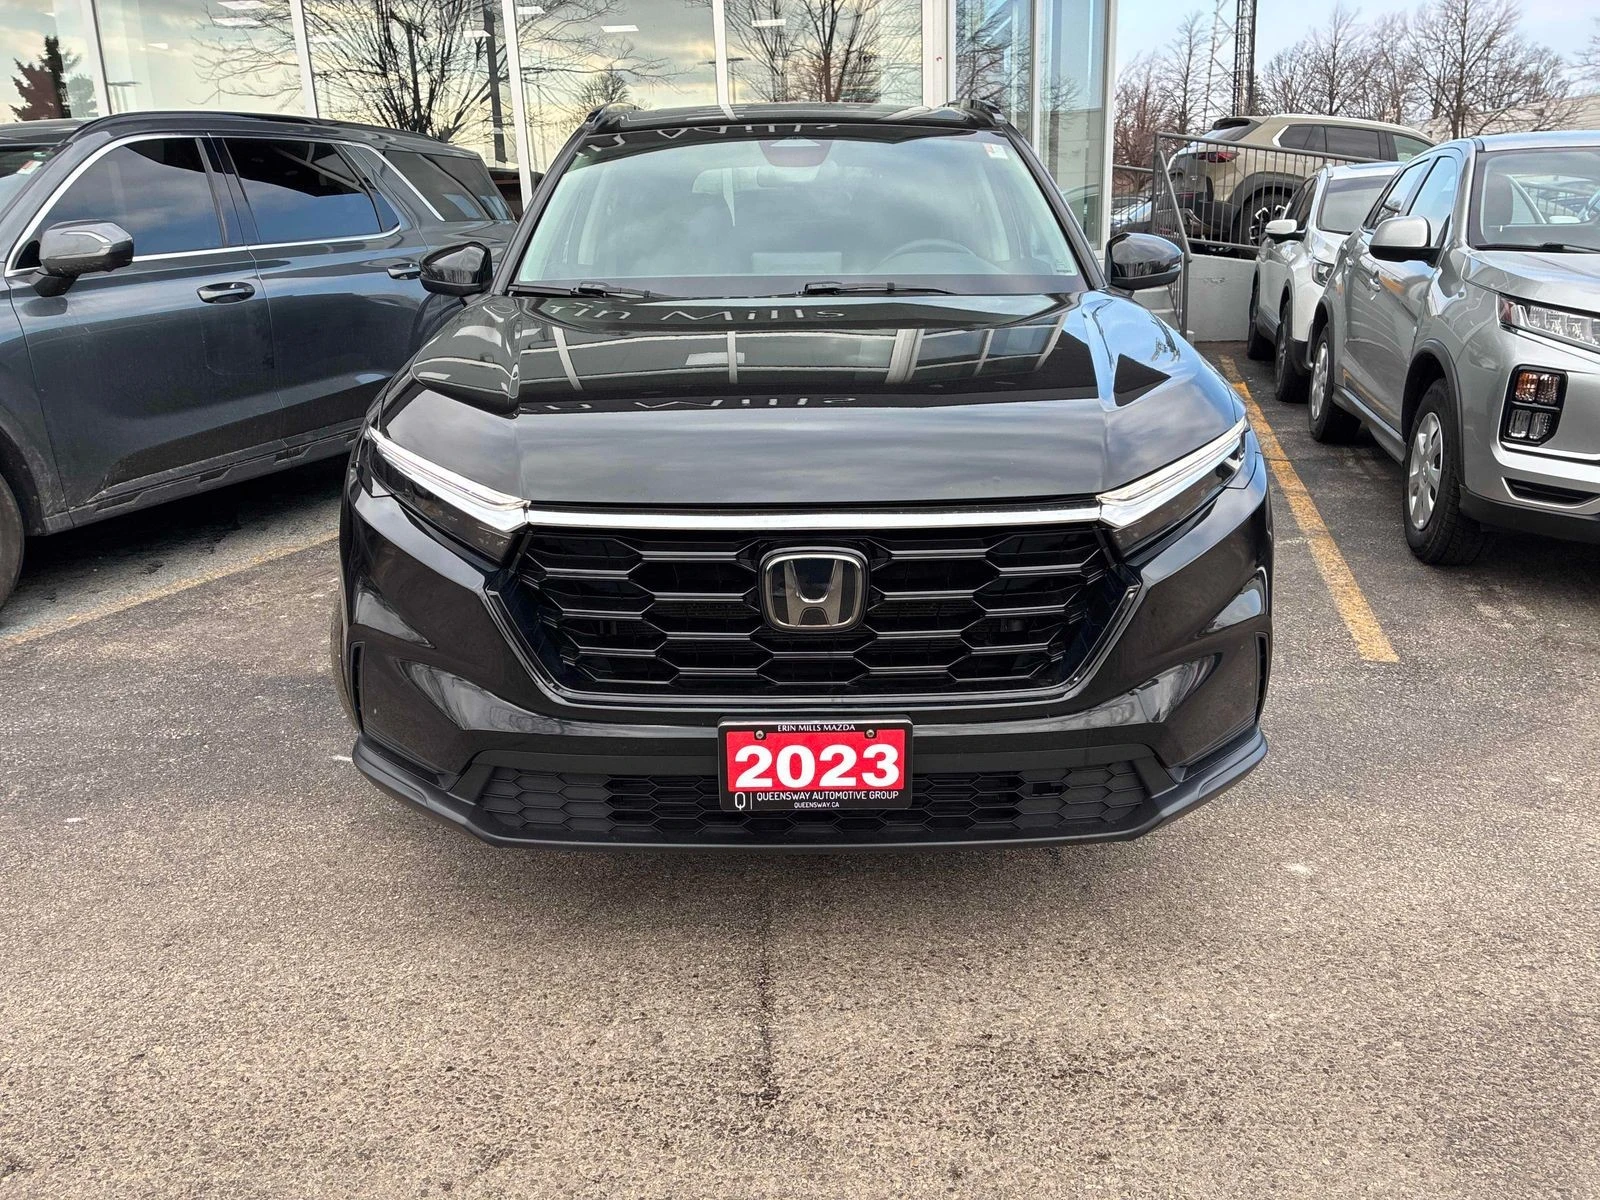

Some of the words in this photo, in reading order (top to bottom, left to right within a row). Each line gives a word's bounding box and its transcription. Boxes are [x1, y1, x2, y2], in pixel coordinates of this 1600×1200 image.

[777, 724, 796, 732] ERIN
[798, 724, 821, 732] MILLS
[822, 724, 856, 732] MAZDA
[734, 743, 900, 788] 2023
[734, 791, 746, 810] Q
[756, 791, 811, 801] QUEENSWAY
[812, 791, 867, 800] AUTOMOTIVE
[869, 791, 899, 800] GROUP
[793, 801, 840, 809] QUEENSWAY.CA
